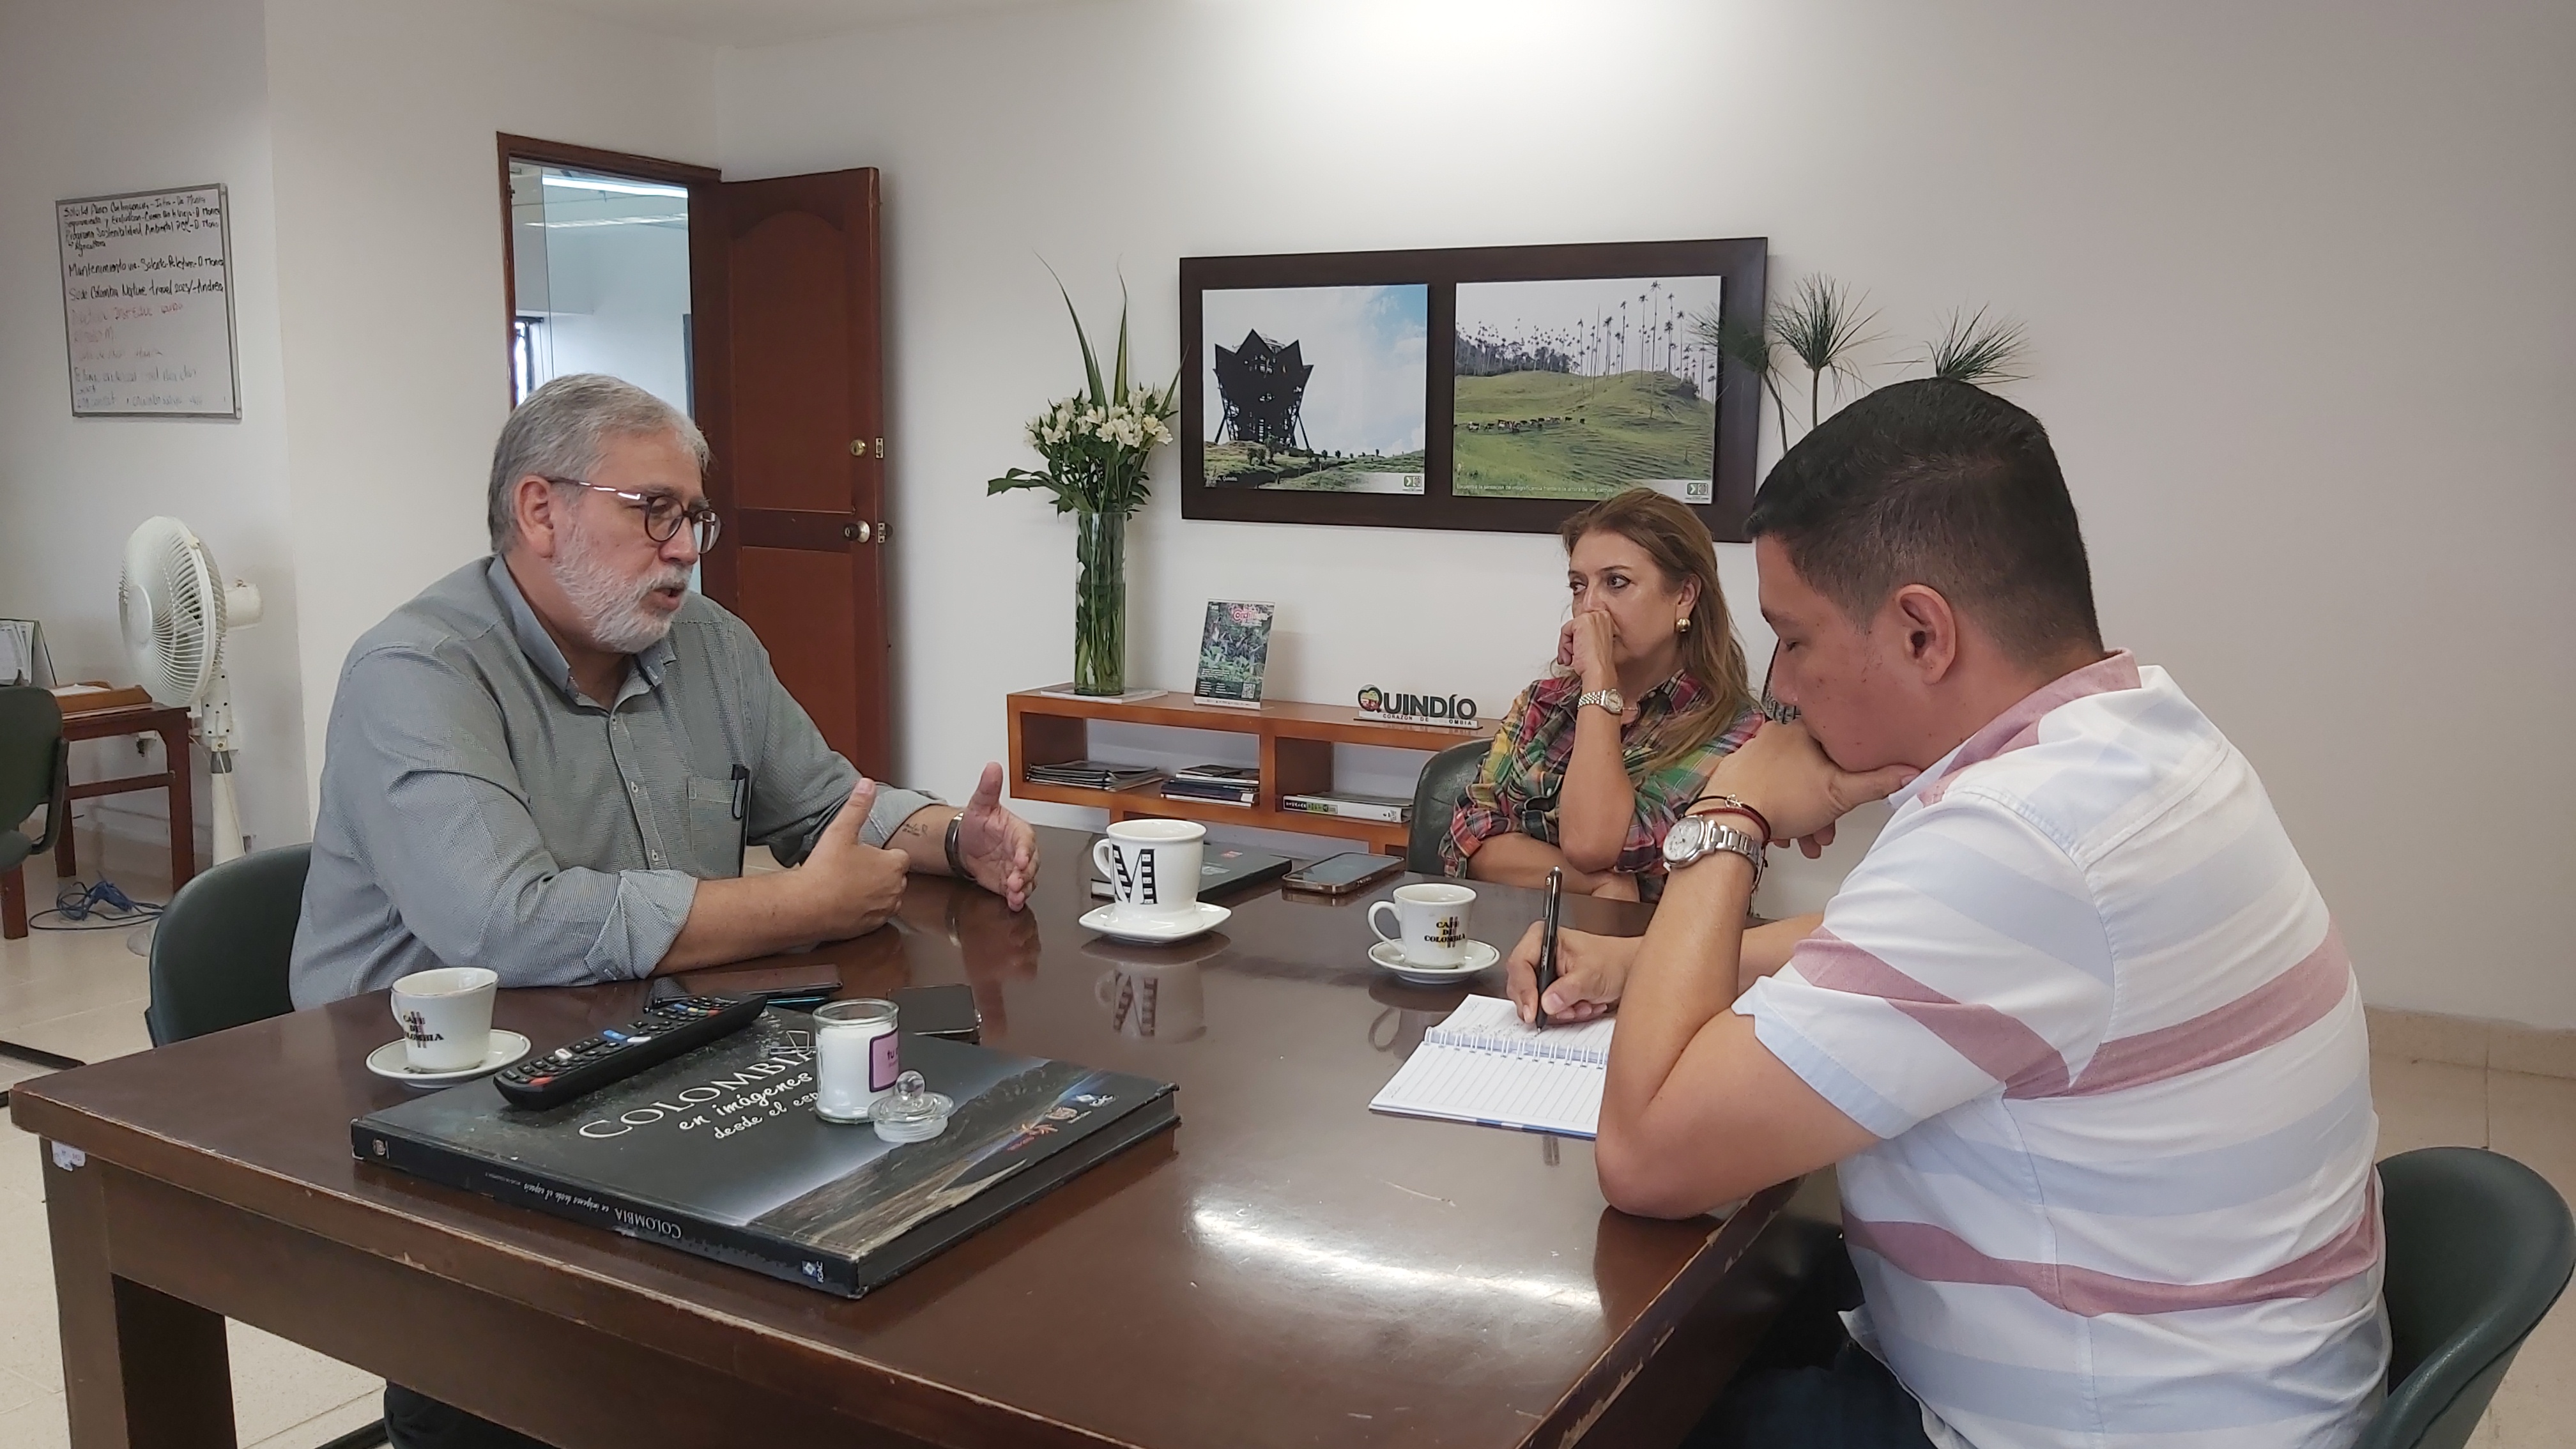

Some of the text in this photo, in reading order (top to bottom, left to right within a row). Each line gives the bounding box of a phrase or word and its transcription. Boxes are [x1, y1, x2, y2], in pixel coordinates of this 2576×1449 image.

[1358, 684, 1477, 720] QUINDÍO
[578, 1048, 816, 1138] COLOMBIA
[678, 1071, 814, 1131] en imágenes
[714, 1115, 763, 1140] desde
[768, 1101, 788, 1117] el
[614, 1207, 682, 1239] COLOMBIA
